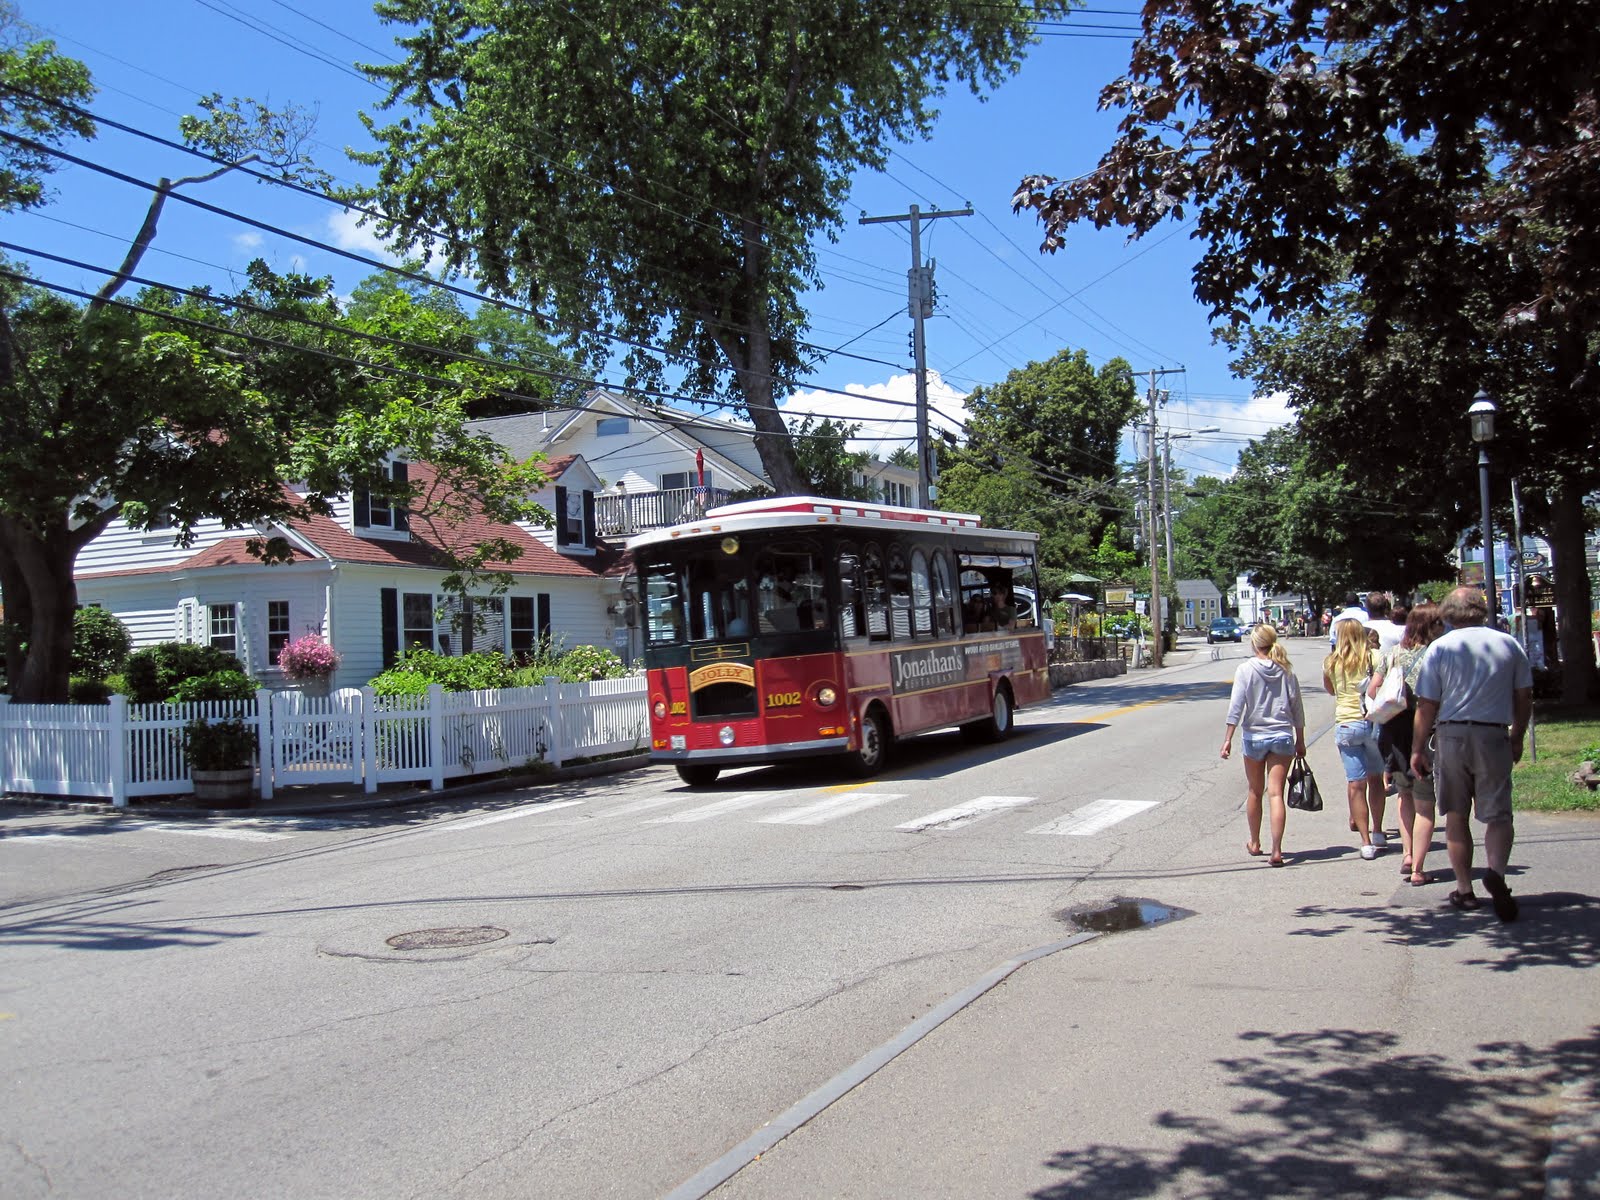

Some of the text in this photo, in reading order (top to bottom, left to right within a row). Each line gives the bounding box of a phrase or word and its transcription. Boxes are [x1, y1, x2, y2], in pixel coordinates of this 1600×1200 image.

[894, 646, 963, 687] Jonathan's
[700, 668, 743, 681] JOLLY
[767, 692, 801, 707] 1002
